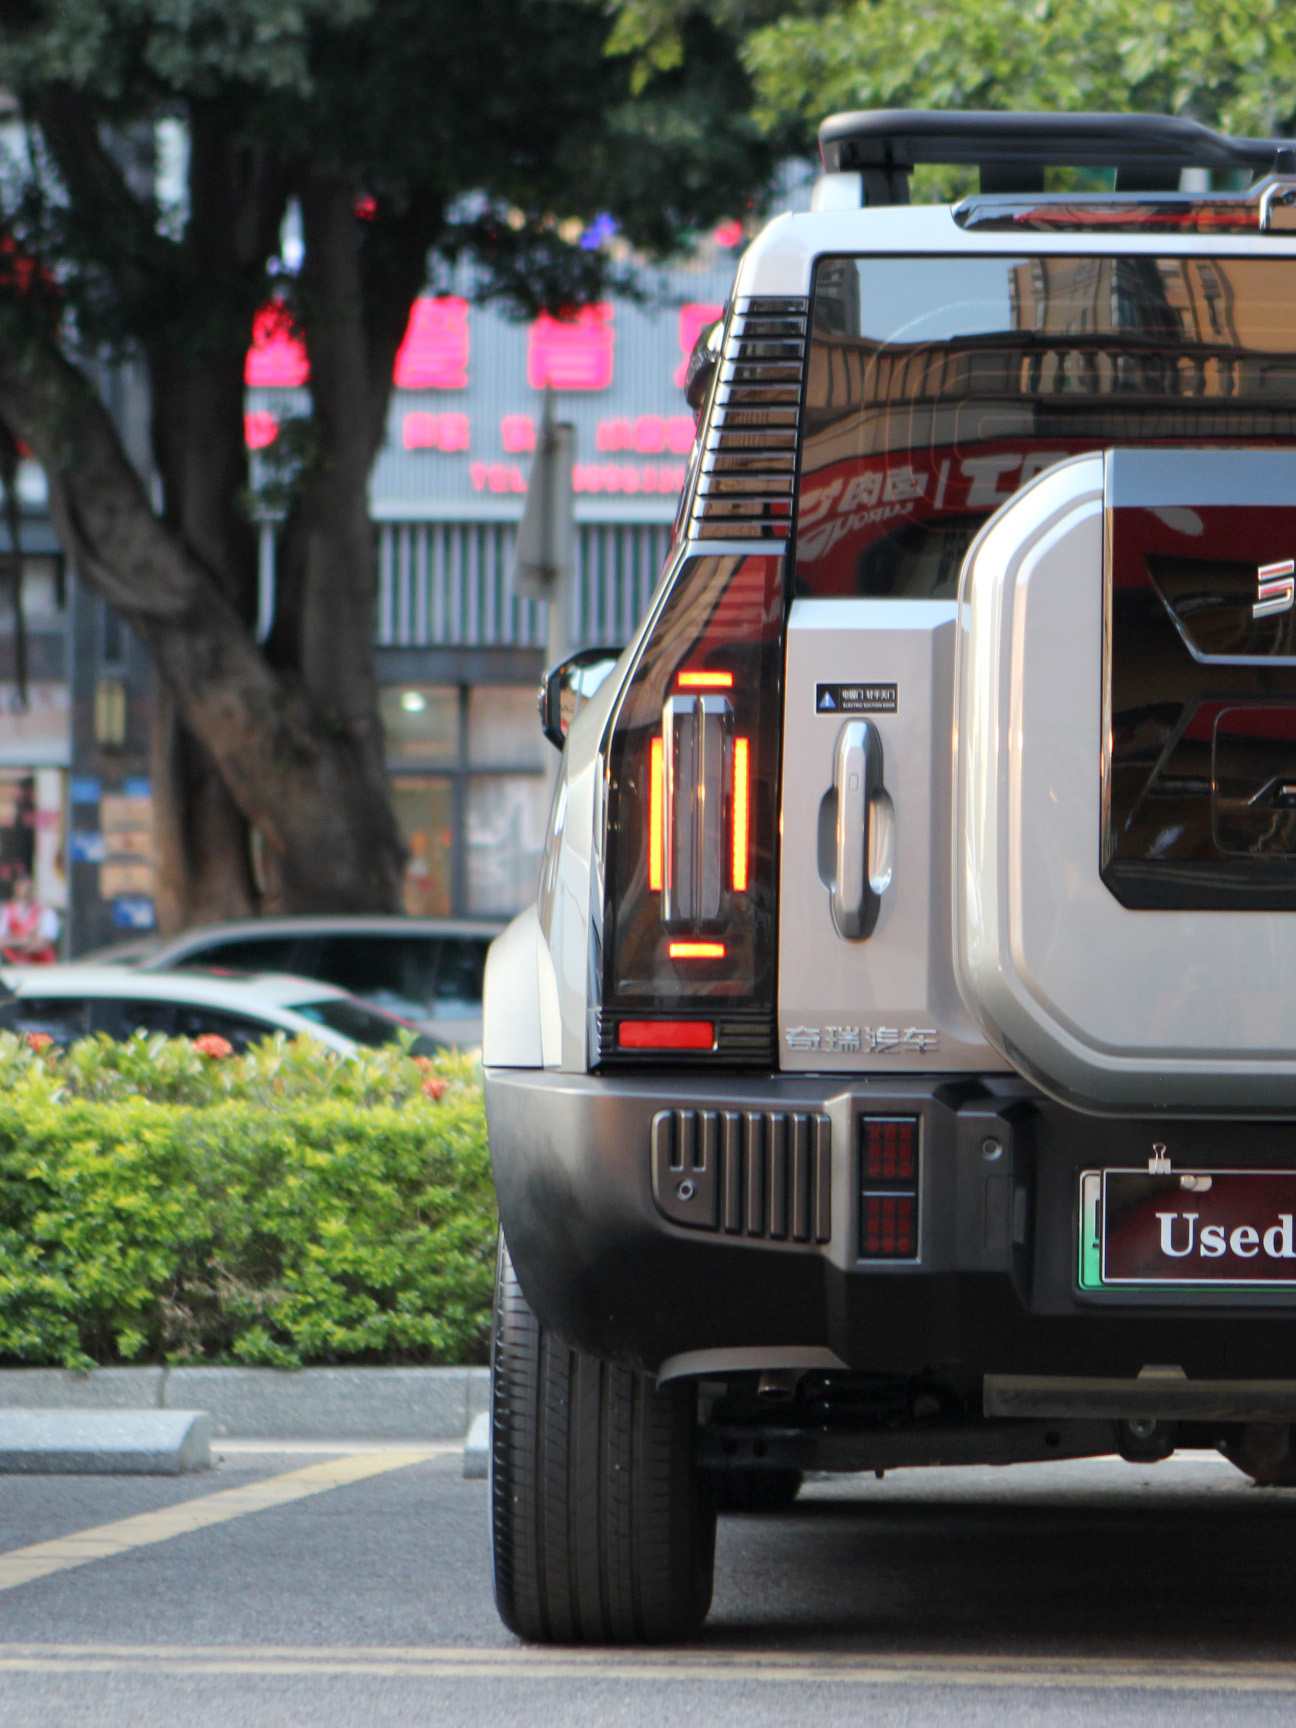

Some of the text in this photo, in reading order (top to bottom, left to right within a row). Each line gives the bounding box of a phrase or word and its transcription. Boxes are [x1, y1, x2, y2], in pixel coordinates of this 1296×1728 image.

[785, 1025, 938, 1054] 奇瑞汽车
[1155, 1212, 1296, 1258] Used
